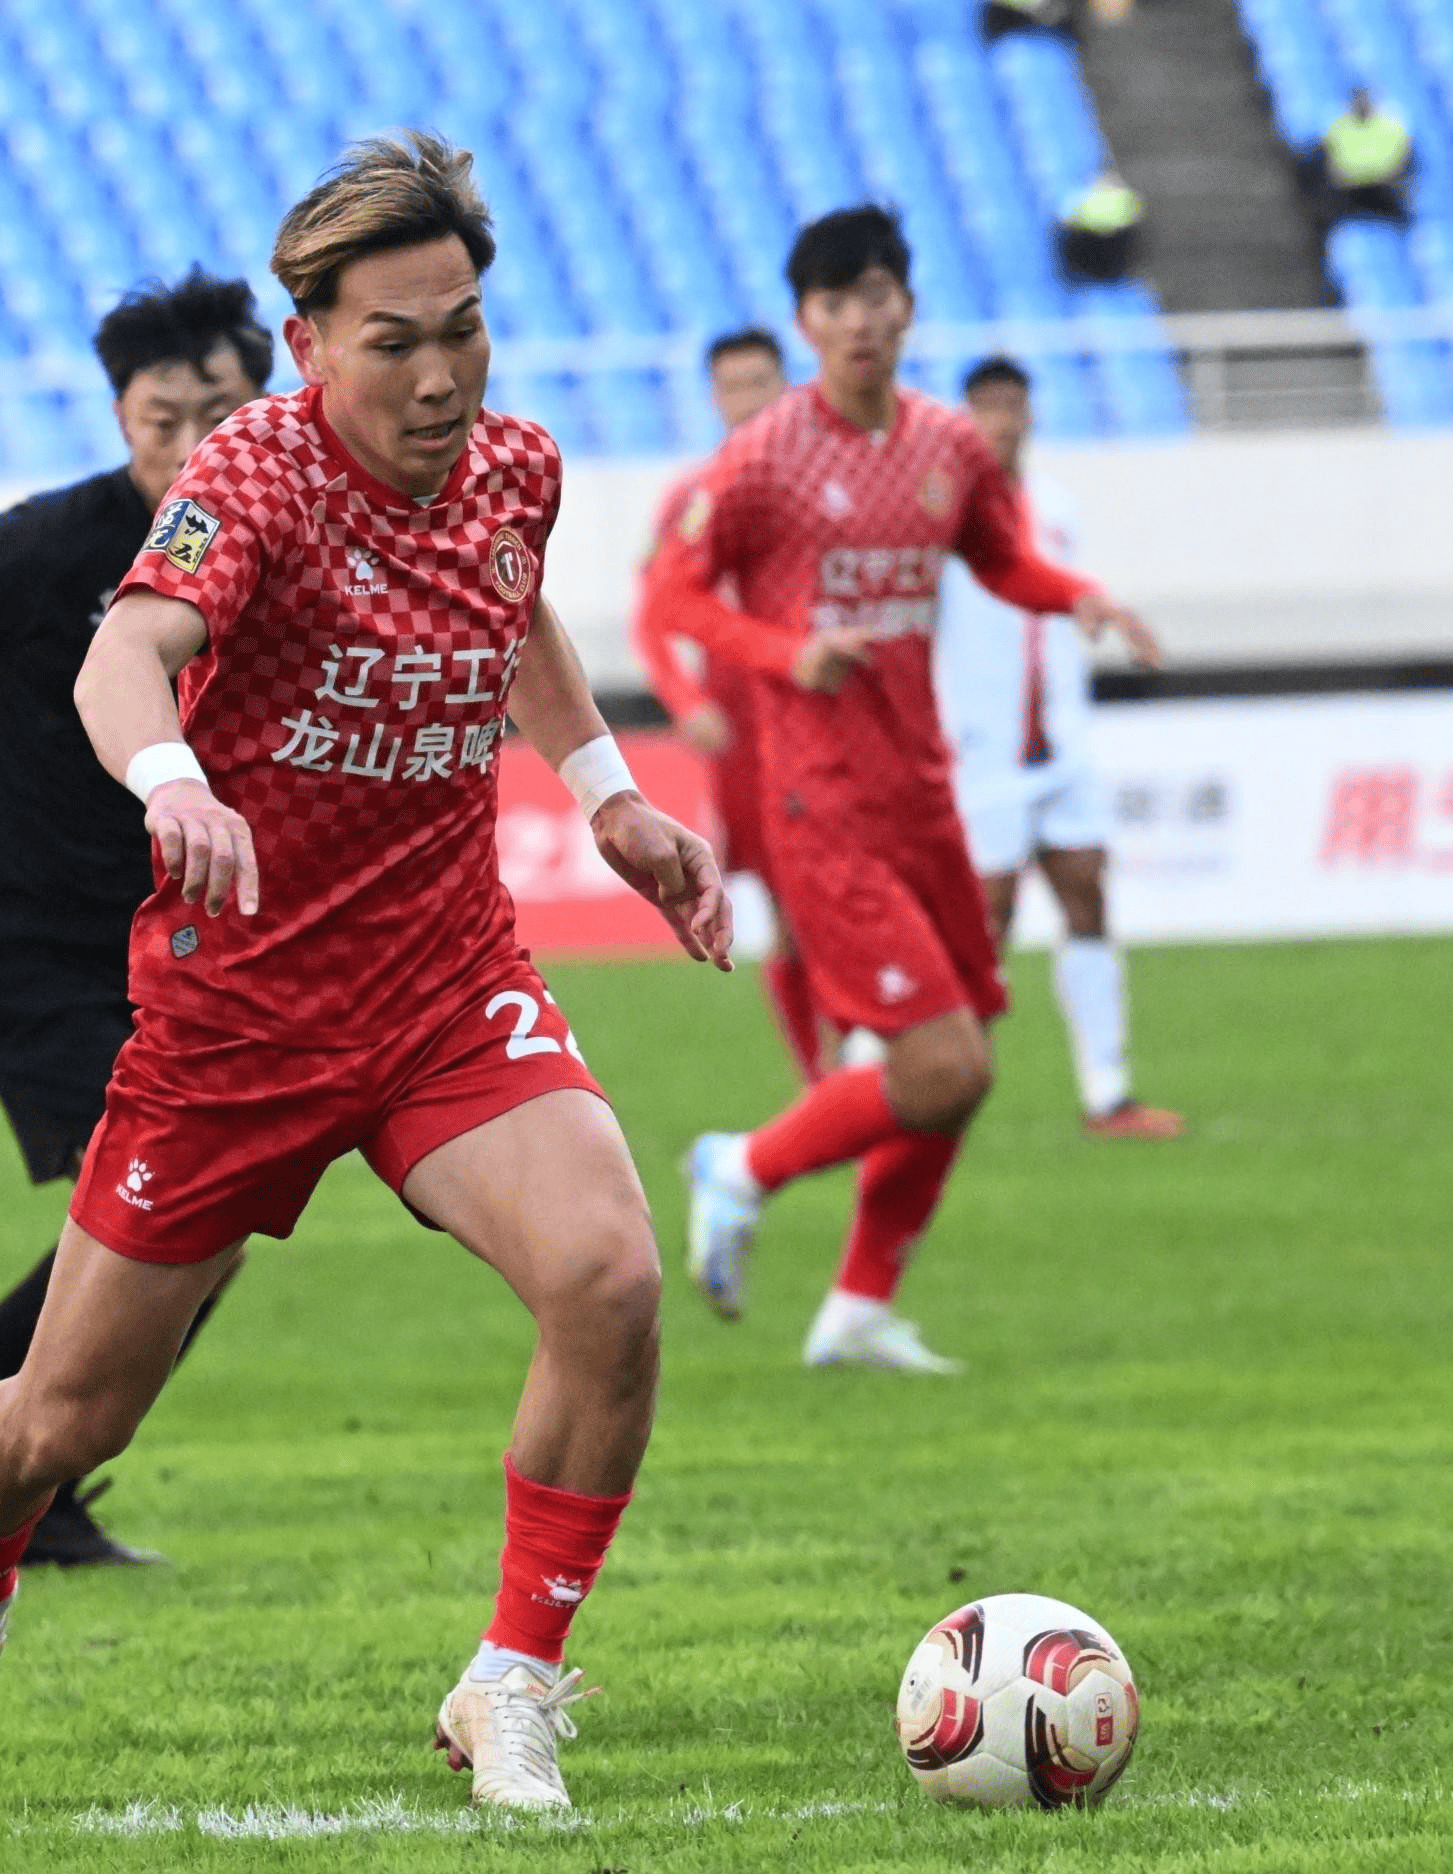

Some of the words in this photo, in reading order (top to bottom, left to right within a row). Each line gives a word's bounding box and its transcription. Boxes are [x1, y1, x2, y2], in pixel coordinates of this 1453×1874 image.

[345, 583, 388, 596] KELME
[270, 709, 506, 782] 龙山泉啤
[485, 990, 587, 1068] 2
[115, 1184, 154, 1212] KELME
